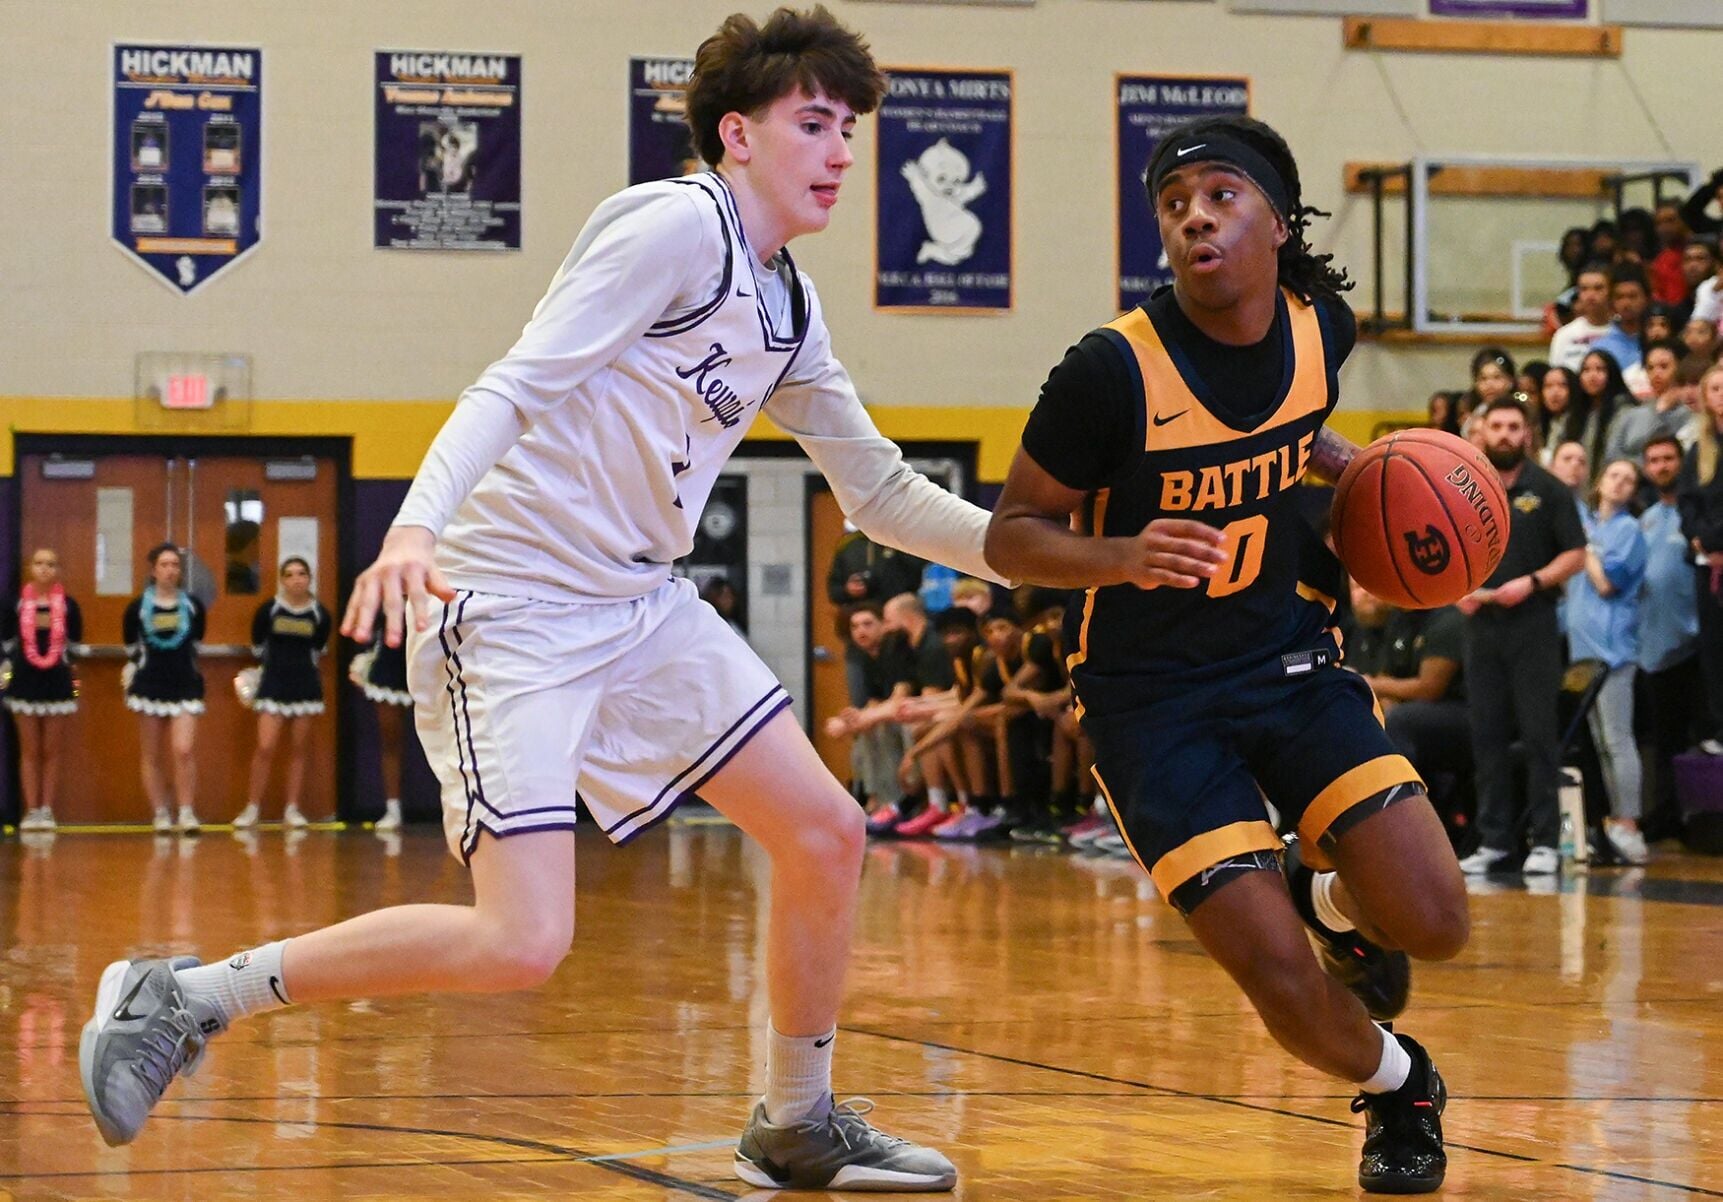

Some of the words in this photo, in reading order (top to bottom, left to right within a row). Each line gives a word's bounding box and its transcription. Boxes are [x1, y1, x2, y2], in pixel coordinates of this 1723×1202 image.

[121, 50, 253, 78] HICKMAN
[390, 54, 506, 79] HICKMAN
[644, 61, 697, 84] HICK
[888, 78, 946, 98] ONYA
[1160, 430, 1314, 511] BATTLE
[1206, 514, 1269, 599] 0
[1317, 655, 1326, 665] M
